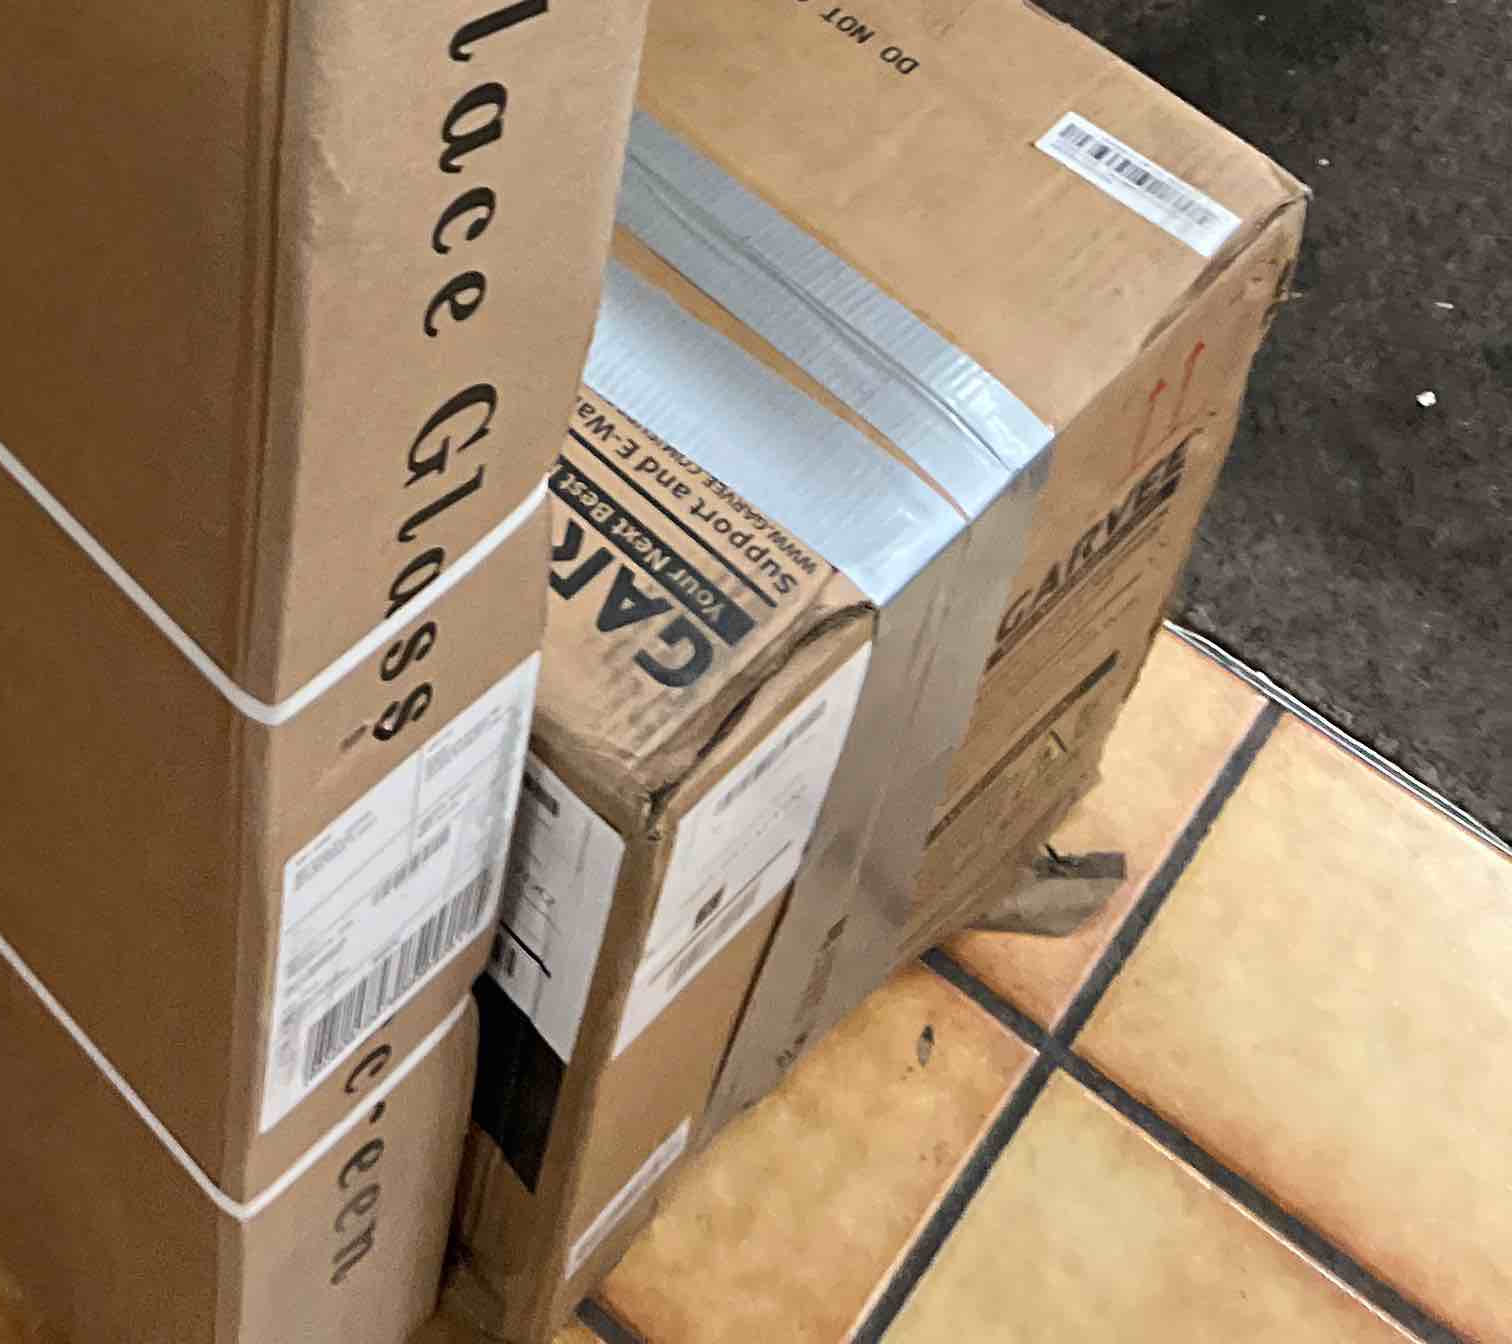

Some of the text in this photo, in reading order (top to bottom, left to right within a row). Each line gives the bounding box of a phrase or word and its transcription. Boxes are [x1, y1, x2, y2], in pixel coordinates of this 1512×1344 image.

[819, 3, 874, 46] NOT
[878, 43, 920, 78] DO
[373, 381, 499, 744] Glass
[556, 470, 722, 622] Your Next Best
[572, 396, 800, 596] Support and E-Wa
